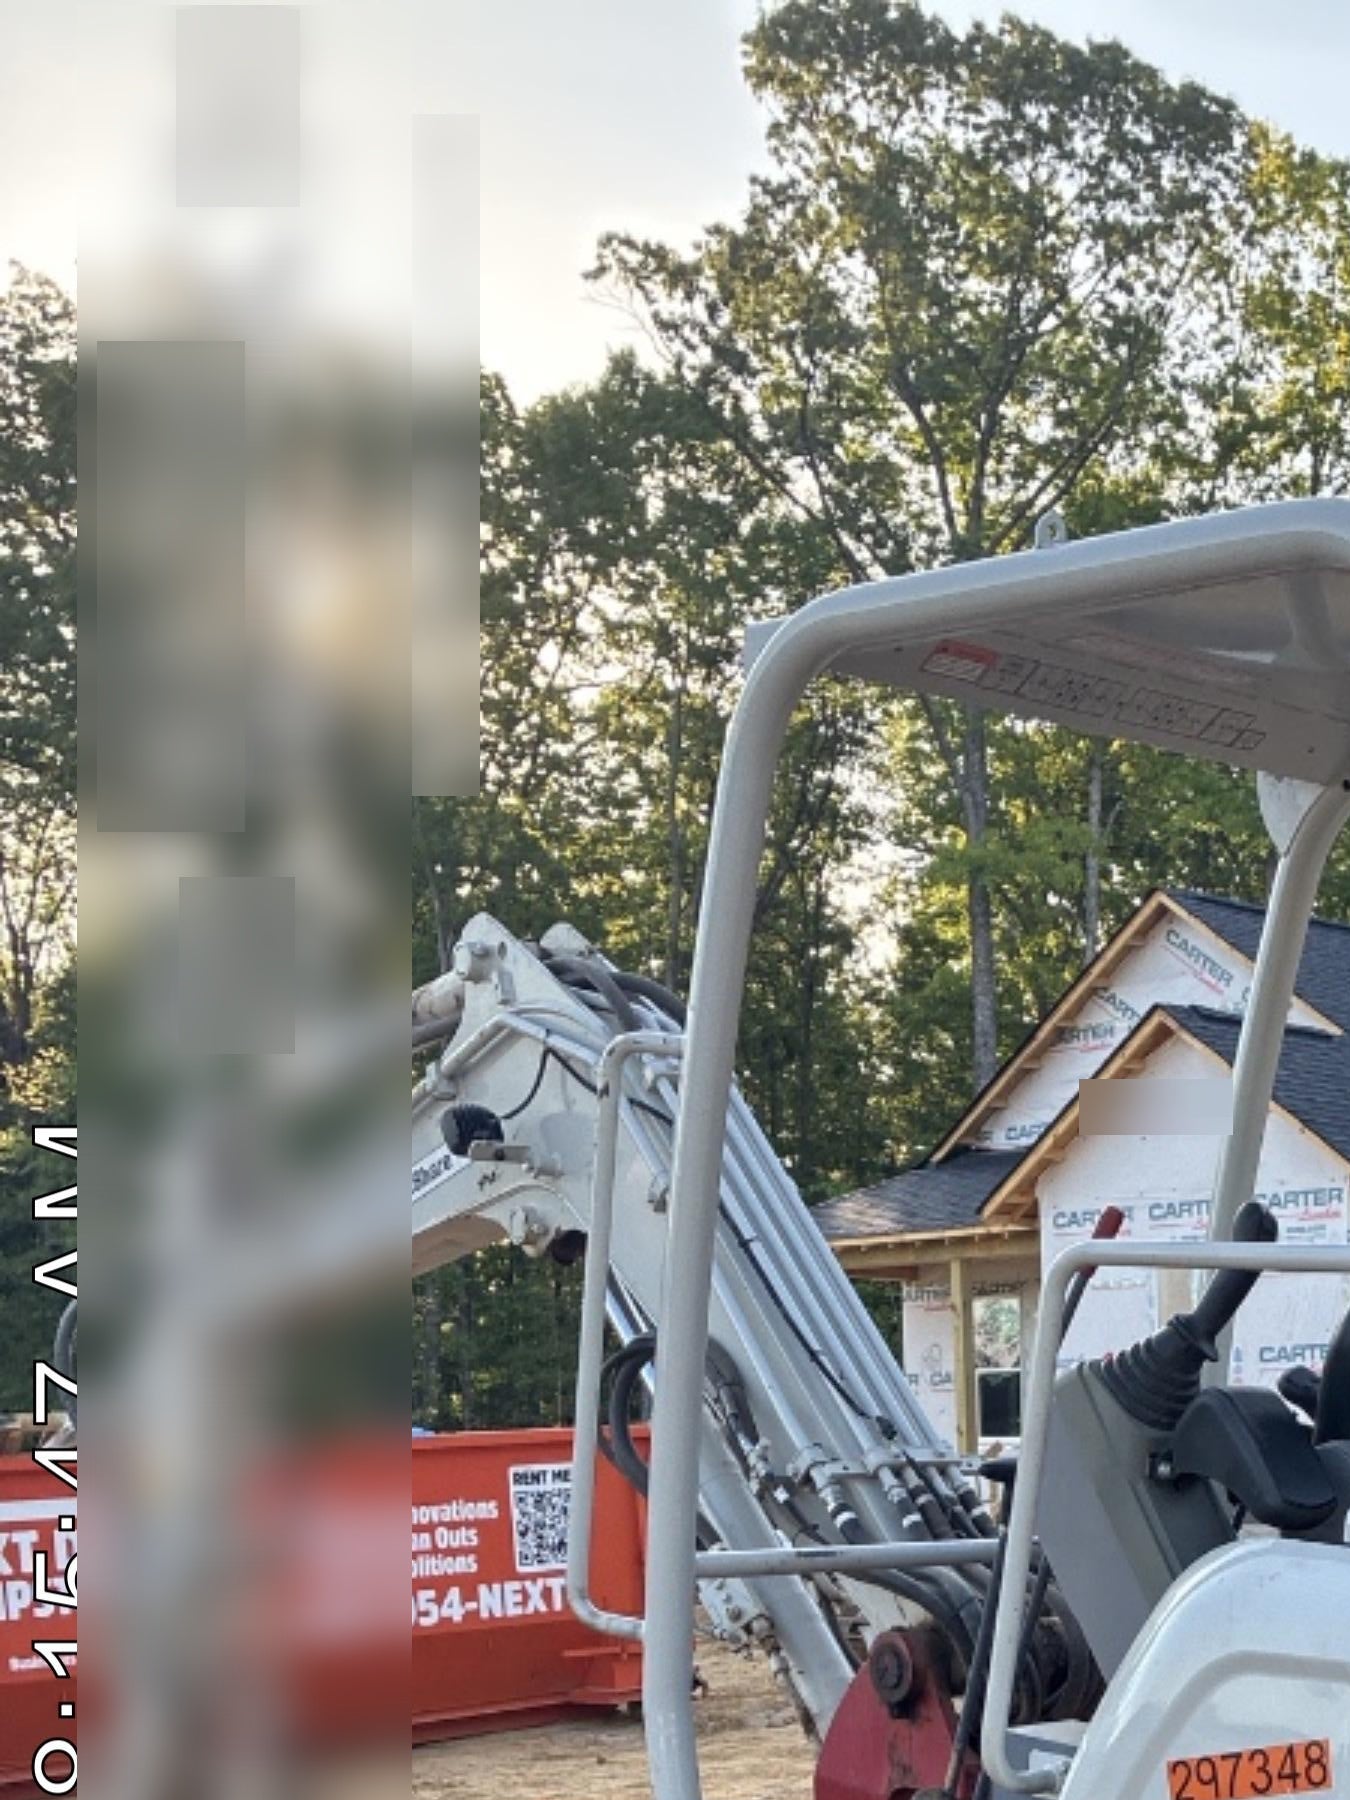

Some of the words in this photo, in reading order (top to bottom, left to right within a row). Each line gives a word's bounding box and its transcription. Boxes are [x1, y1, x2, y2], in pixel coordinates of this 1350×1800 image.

[1164, 927, 1235, 988] CARTER
[512, 1469, 549, 1486] RENT
[552, 1468, 572, 1483] ME
[434, 1526, 479, 1549] Outs
